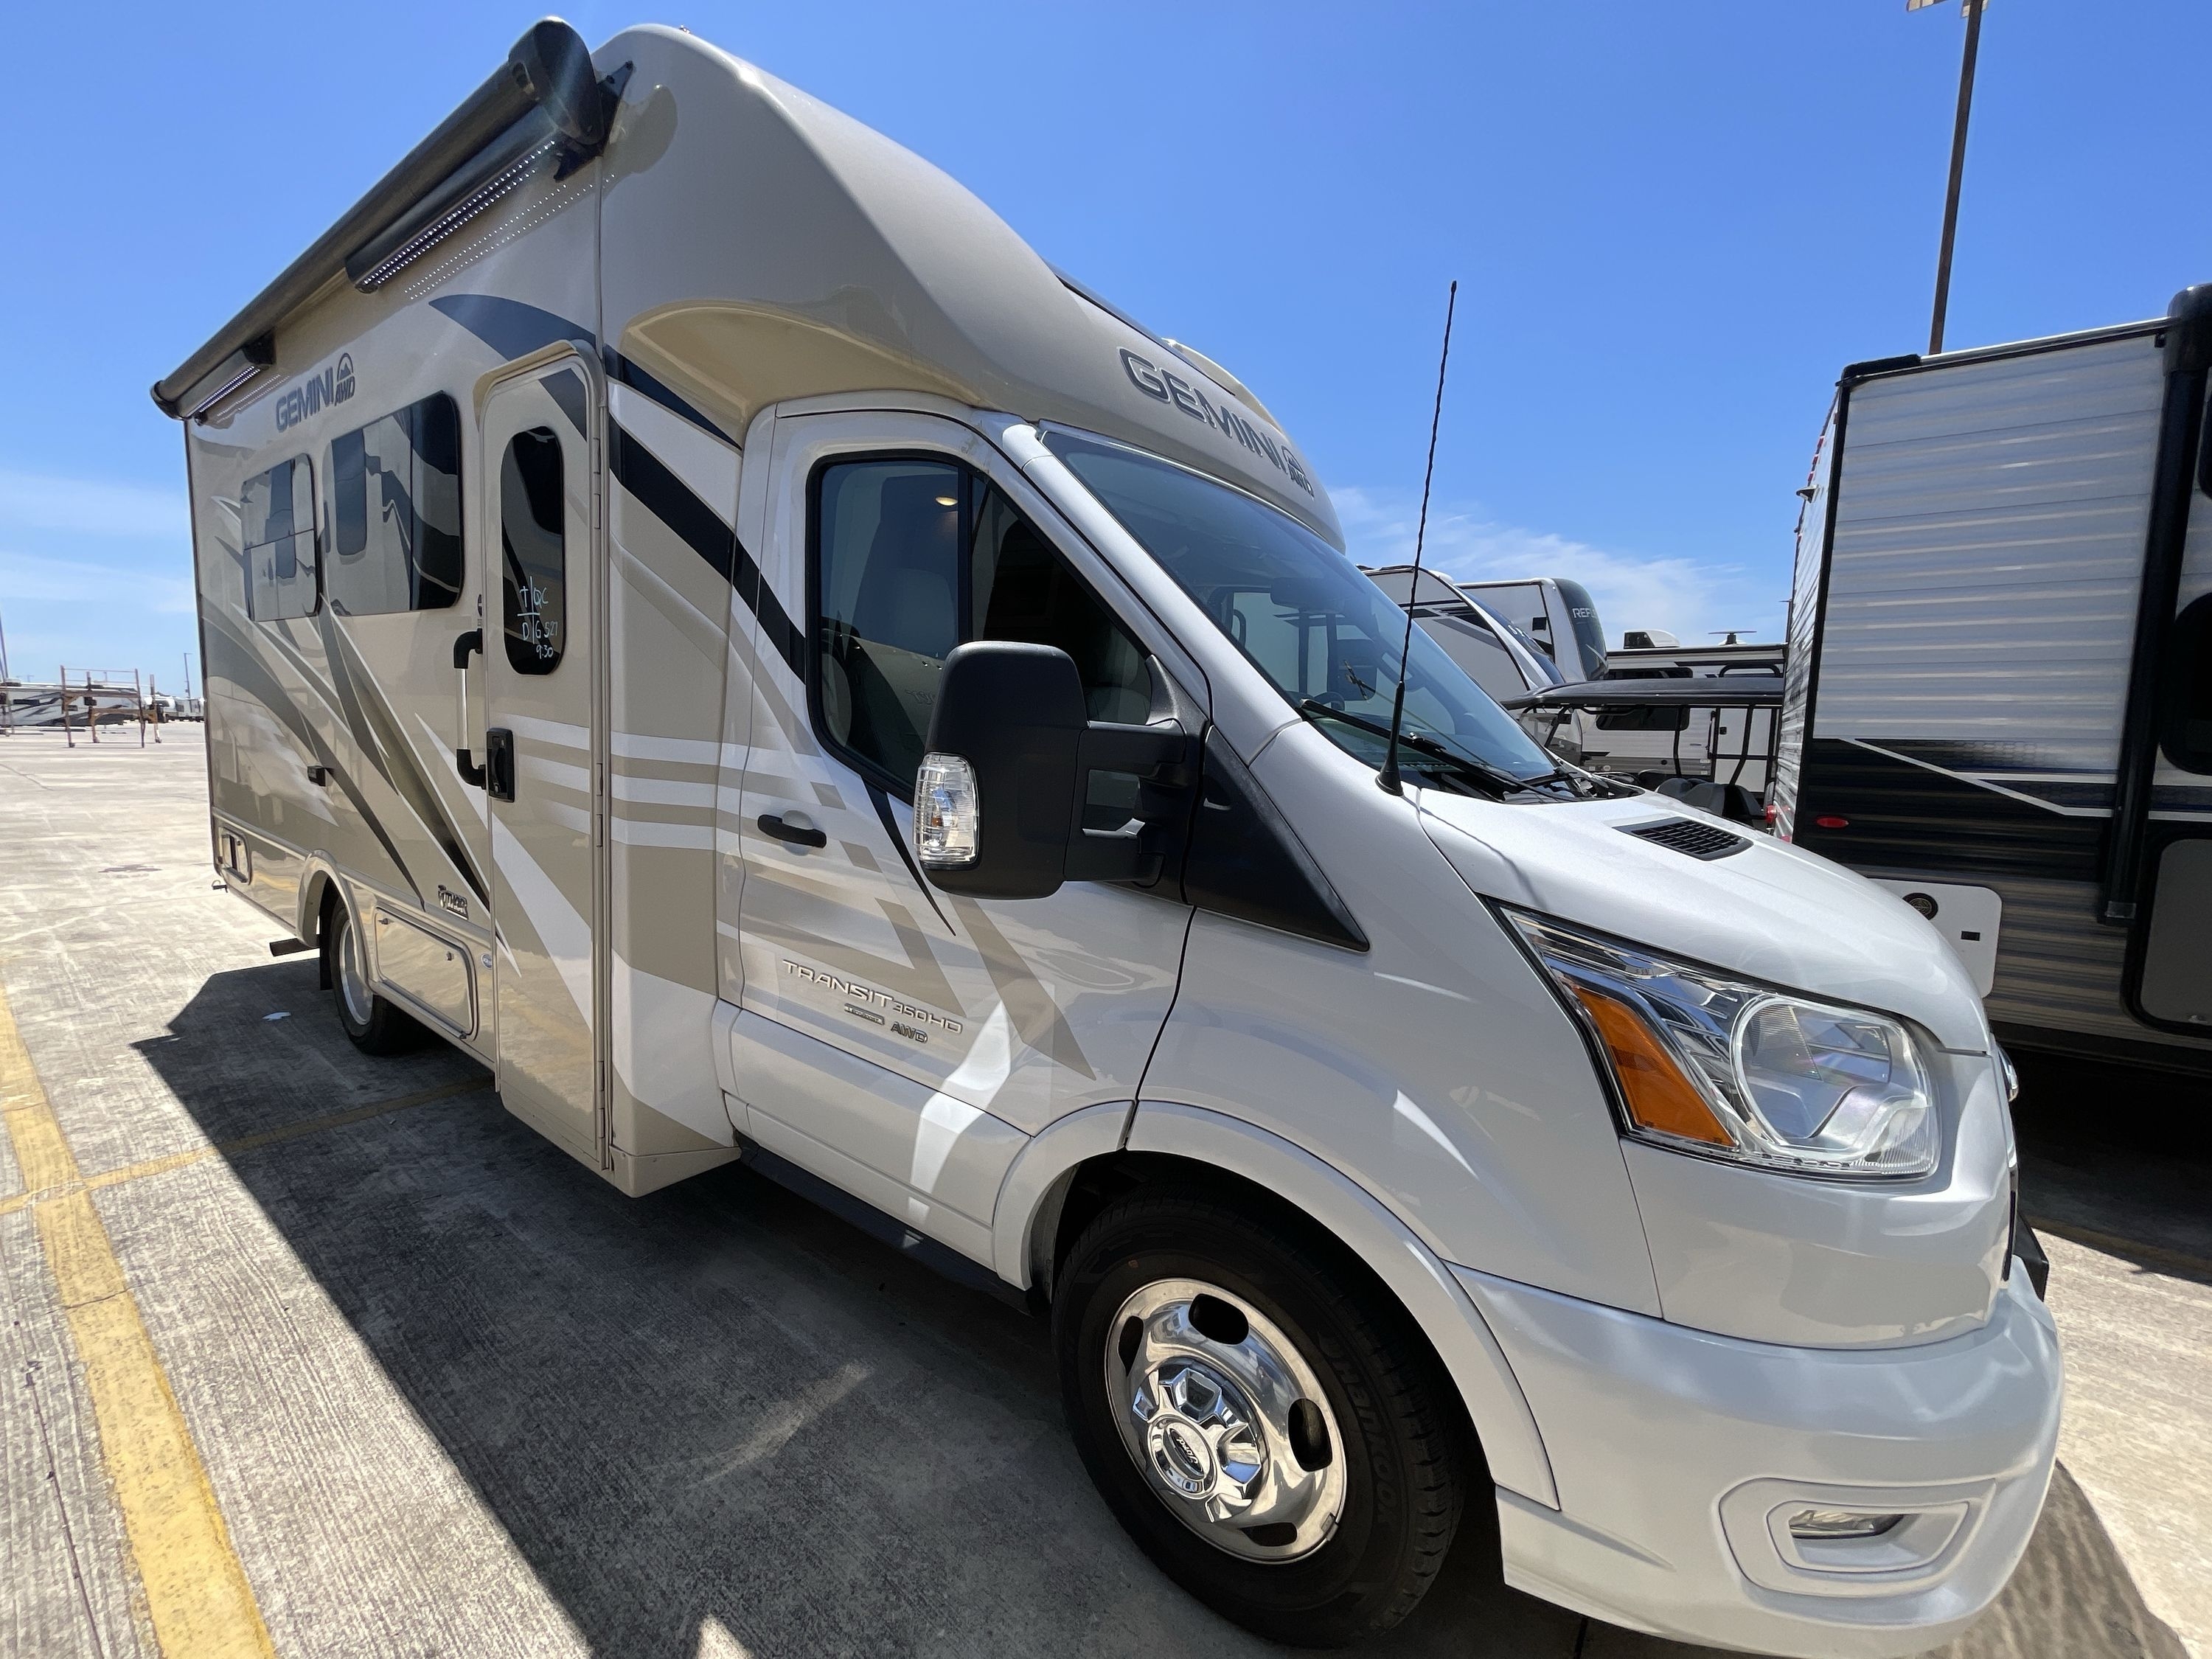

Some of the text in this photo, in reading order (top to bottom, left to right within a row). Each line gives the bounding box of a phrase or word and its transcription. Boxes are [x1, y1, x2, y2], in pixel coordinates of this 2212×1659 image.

[276, 366, 355, 434] GEMINI AWD
[1117, 347, 1287, 474] GEMINI
[782, 959, 894, 1007] TRANSIT
[891, 1020, 928, 1043] AWD
[1175, 1436, 1199, 1464] Ford
